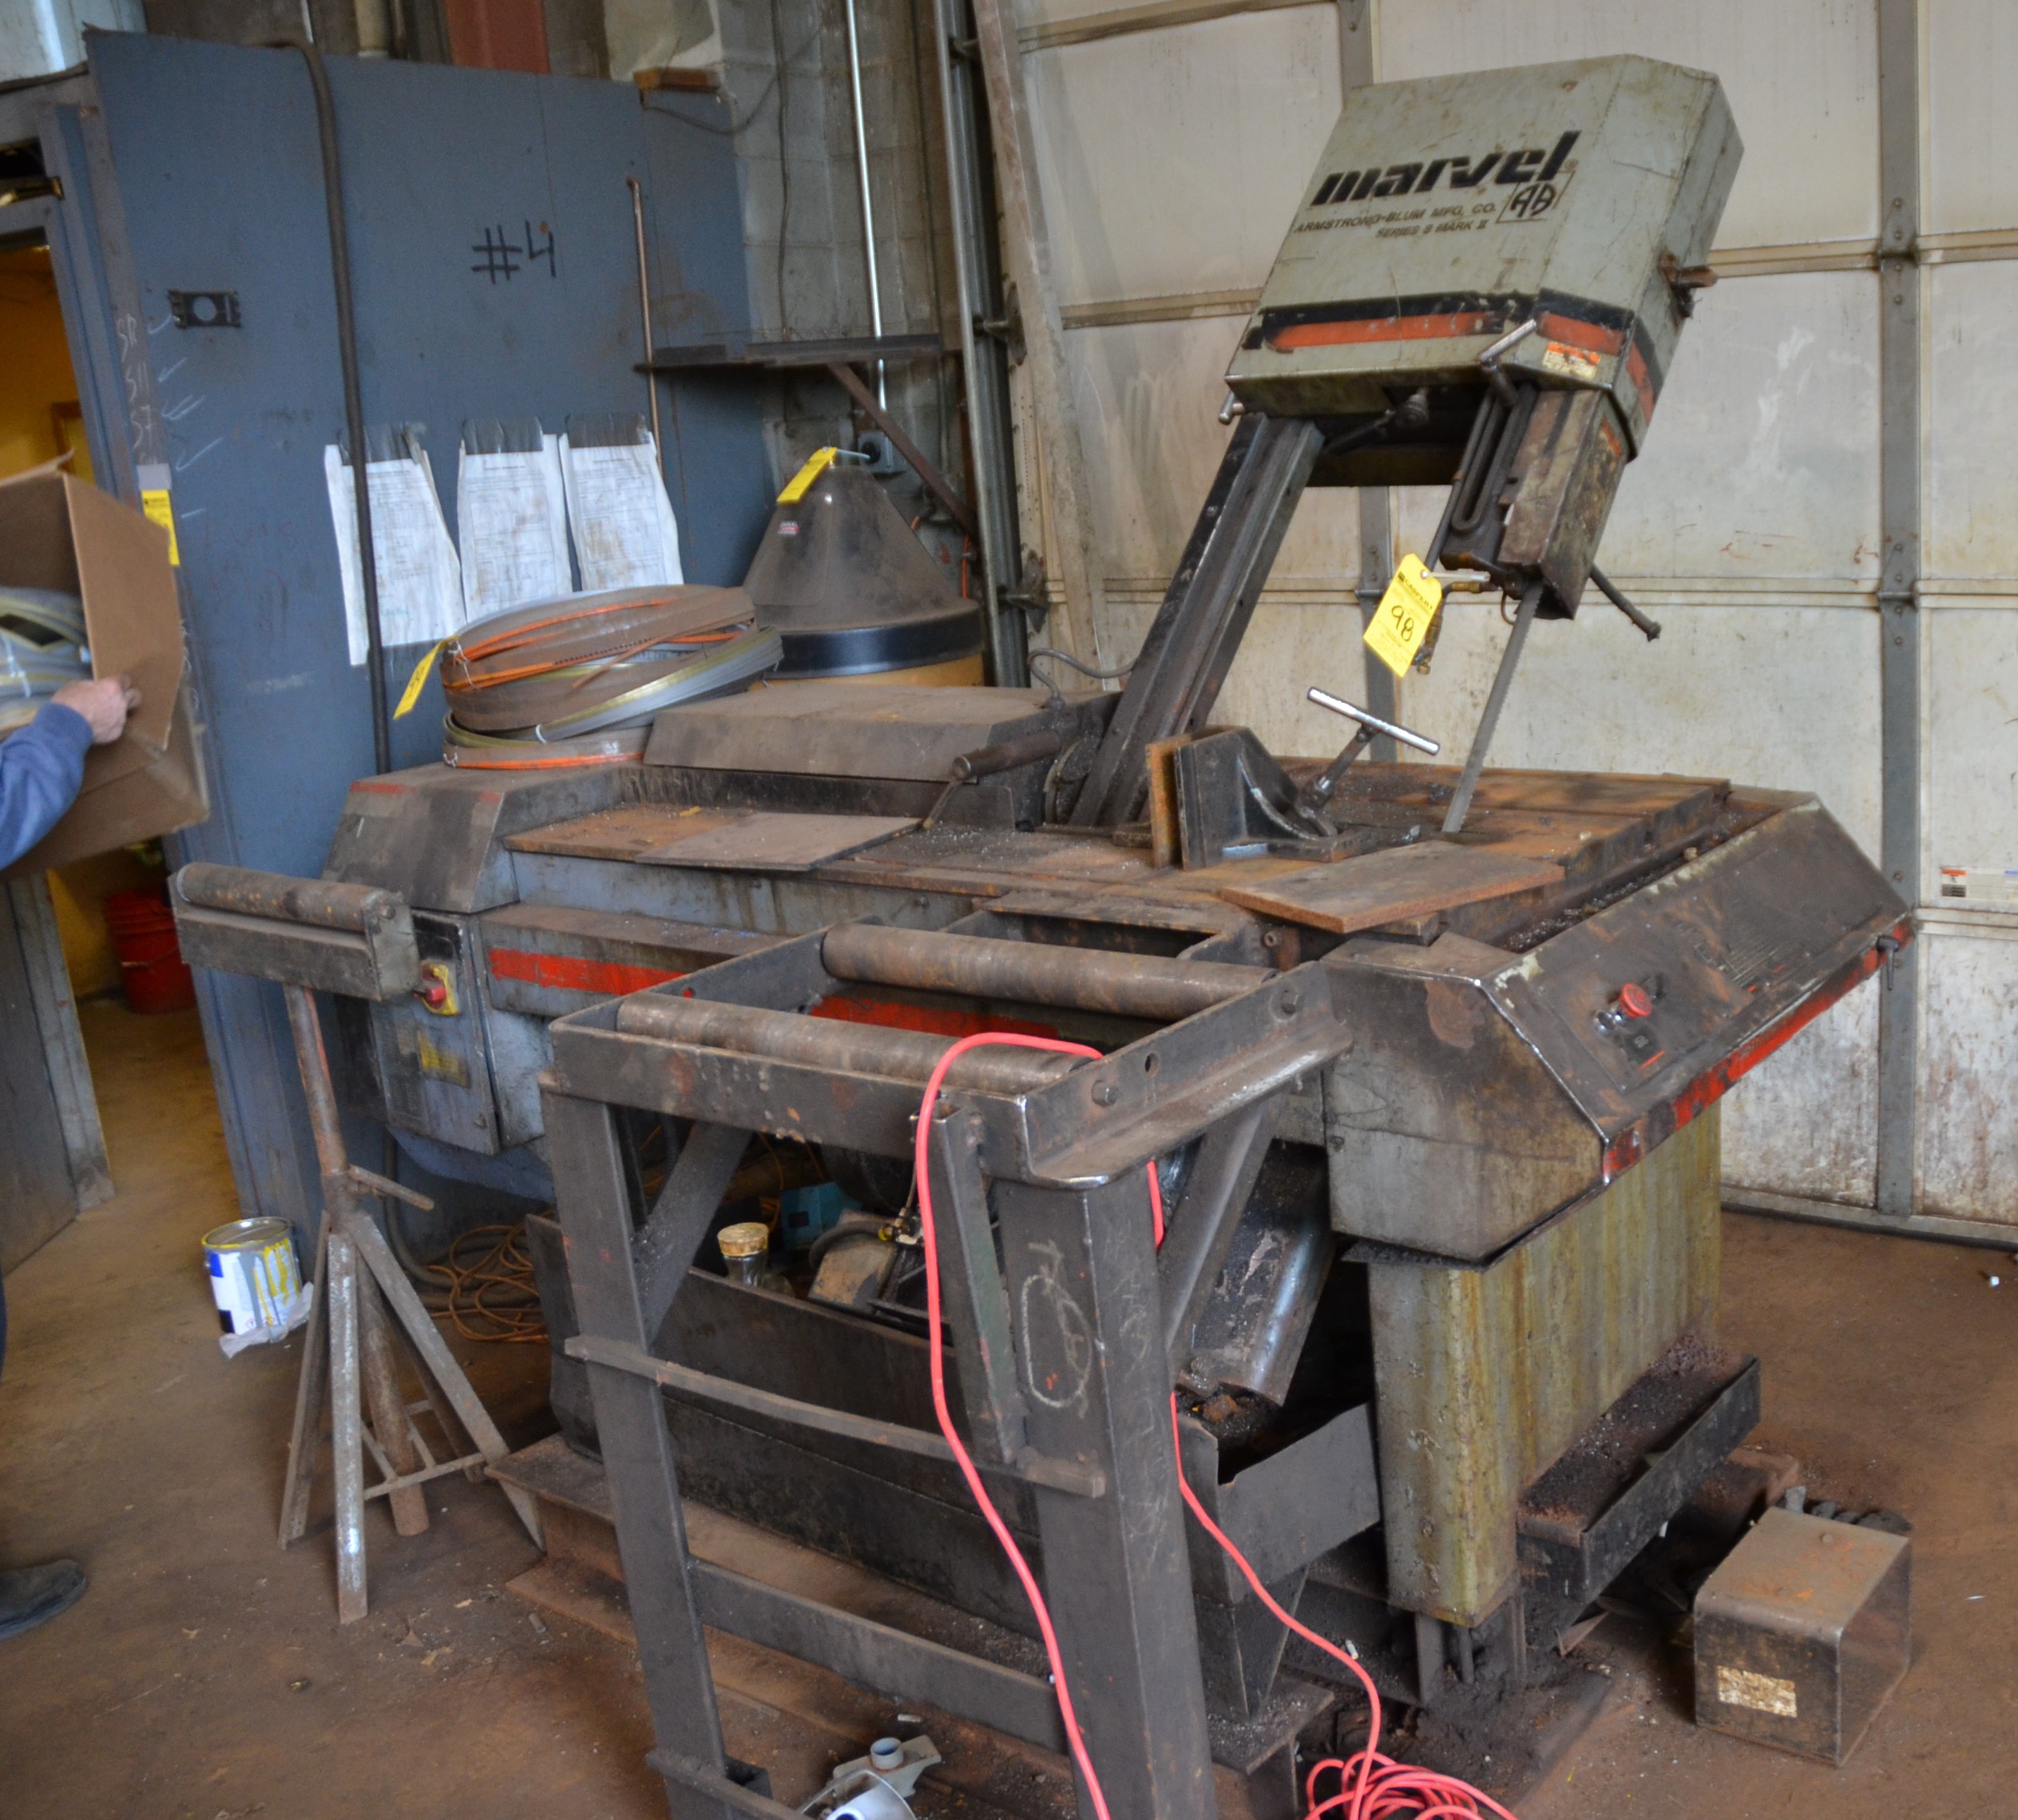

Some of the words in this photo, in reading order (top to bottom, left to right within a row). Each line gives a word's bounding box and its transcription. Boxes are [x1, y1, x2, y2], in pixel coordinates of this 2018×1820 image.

[1310, 130, 1582, 206] marvel
[1294, 208, 1427, 233] ARMSTRONG-BLUM
[1376, 224, 1420, 239] SERIES
[1434, 220, 1473, 233] MARK
[471, 220, 557, 284] #4
[1391, 605, 1414, 642] 98
